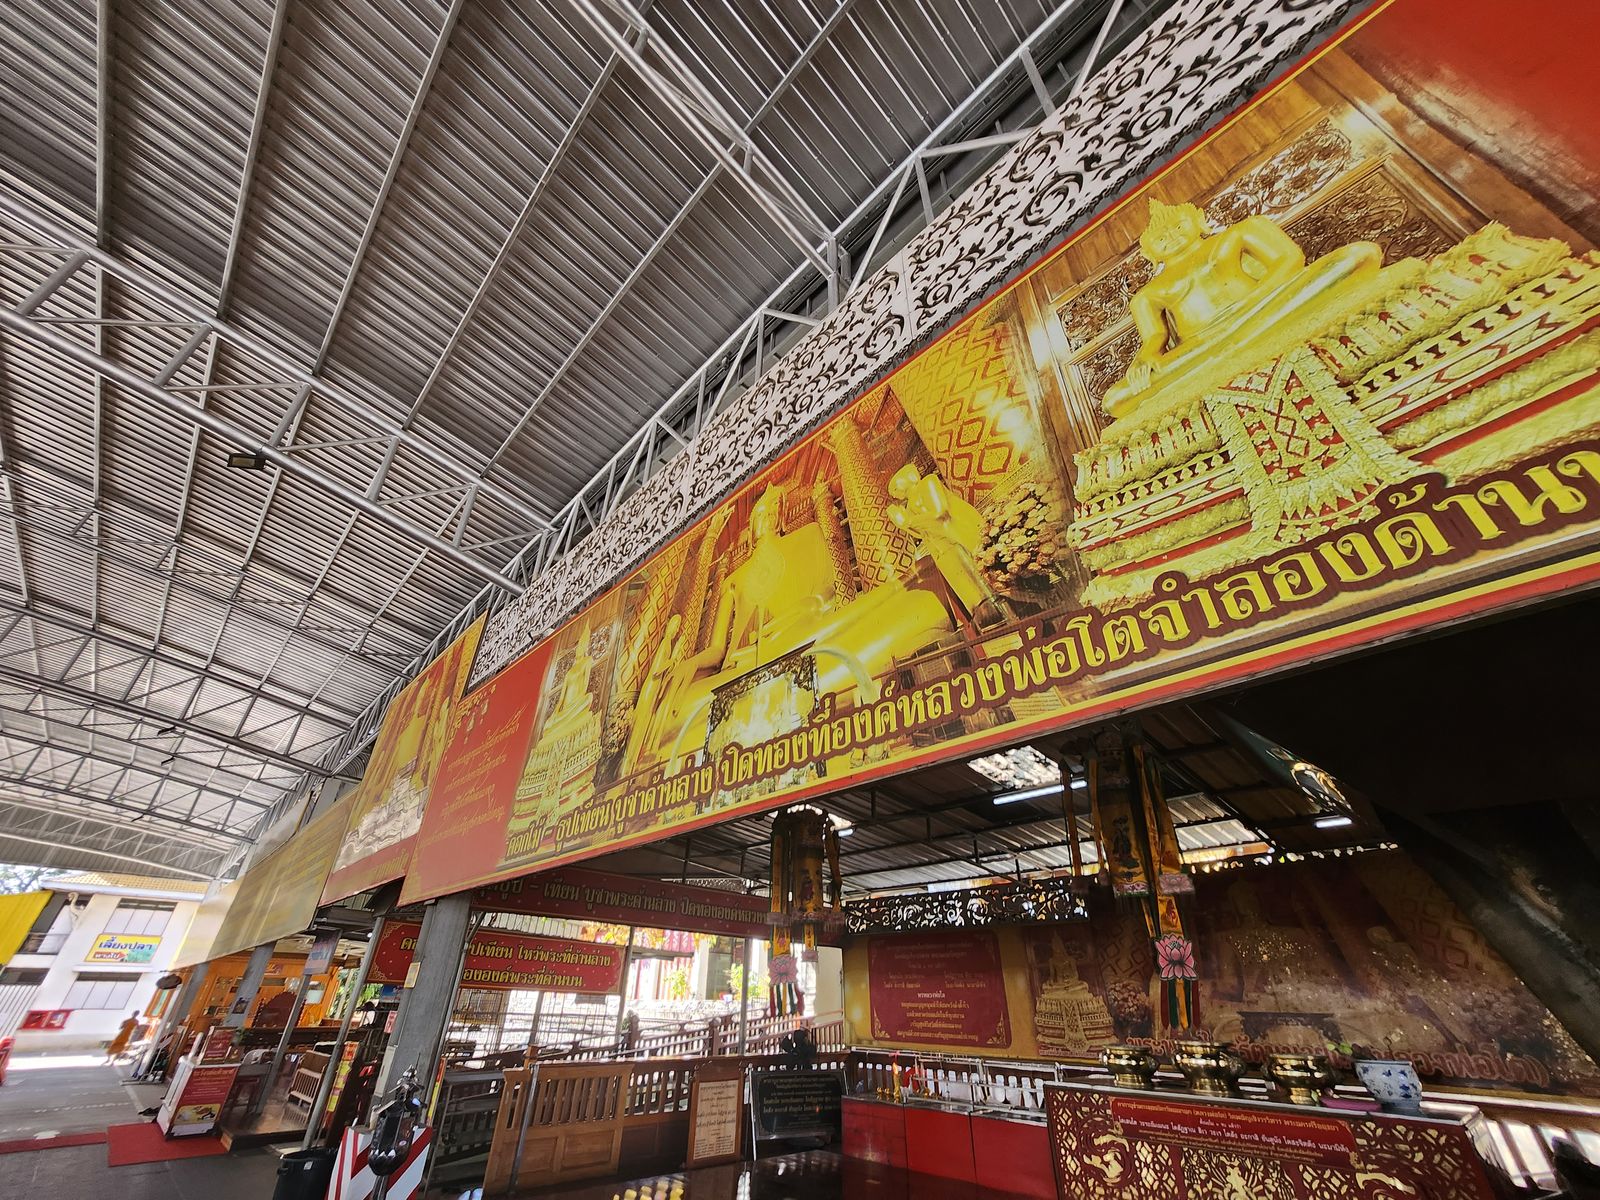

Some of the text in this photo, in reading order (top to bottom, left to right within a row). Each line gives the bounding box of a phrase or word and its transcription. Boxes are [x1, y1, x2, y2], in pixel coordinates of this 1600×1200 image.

[555, 801, 609, 852] ธูปเทียน
[613, 757, 713, 834] บูชาด้านล่าง
[98, 936, 153, 951] เลี้ยงปลา
[467, 940, 611, 967] ปเทียน ไหว้พระที่ด้านล่าง
[463, 966, 583, 987] ององค์พระที่ด้านบน
